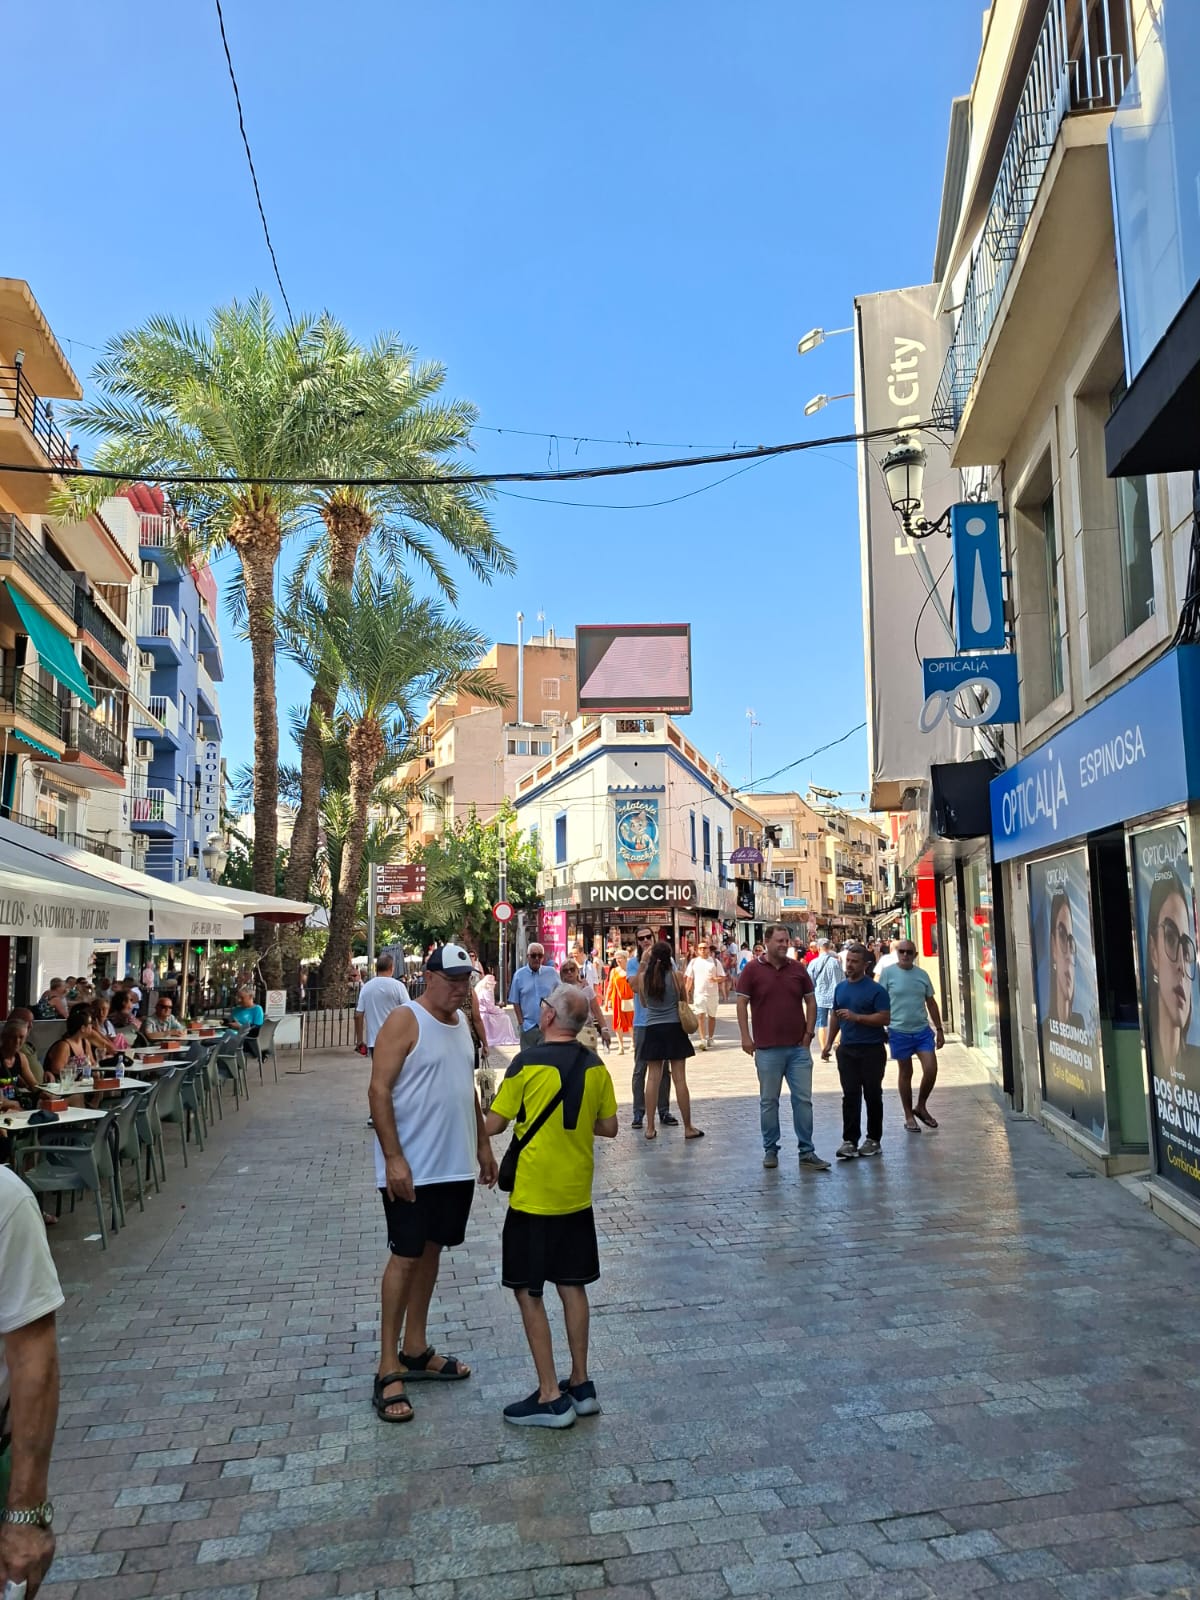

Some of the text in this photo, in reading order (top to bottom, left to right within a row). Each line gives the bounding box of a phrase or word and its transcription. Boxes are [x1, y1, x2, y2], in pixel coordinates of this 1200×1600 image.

[887, 337, 927, 407] City
[1079, 724, 1146, 788] ESPINOSA
[205, 752, 217, 805] HOTEL
[1154, 871, 1173, 881] ESPINOSA
[590, 885, 691, 902] PINOCCHIO
[0, 899, 110, 930] LLOS SANDWICH HOT DOG
[1048, 1019, 1088, 1046] LES SEGUIMOS
[1049, 1040, 1092, 1072] ATENDIENDO EN
[1153, 1076, 1200, 1115] DOS GAFA
[1158, 1098, 1182, 1129] PAGA
